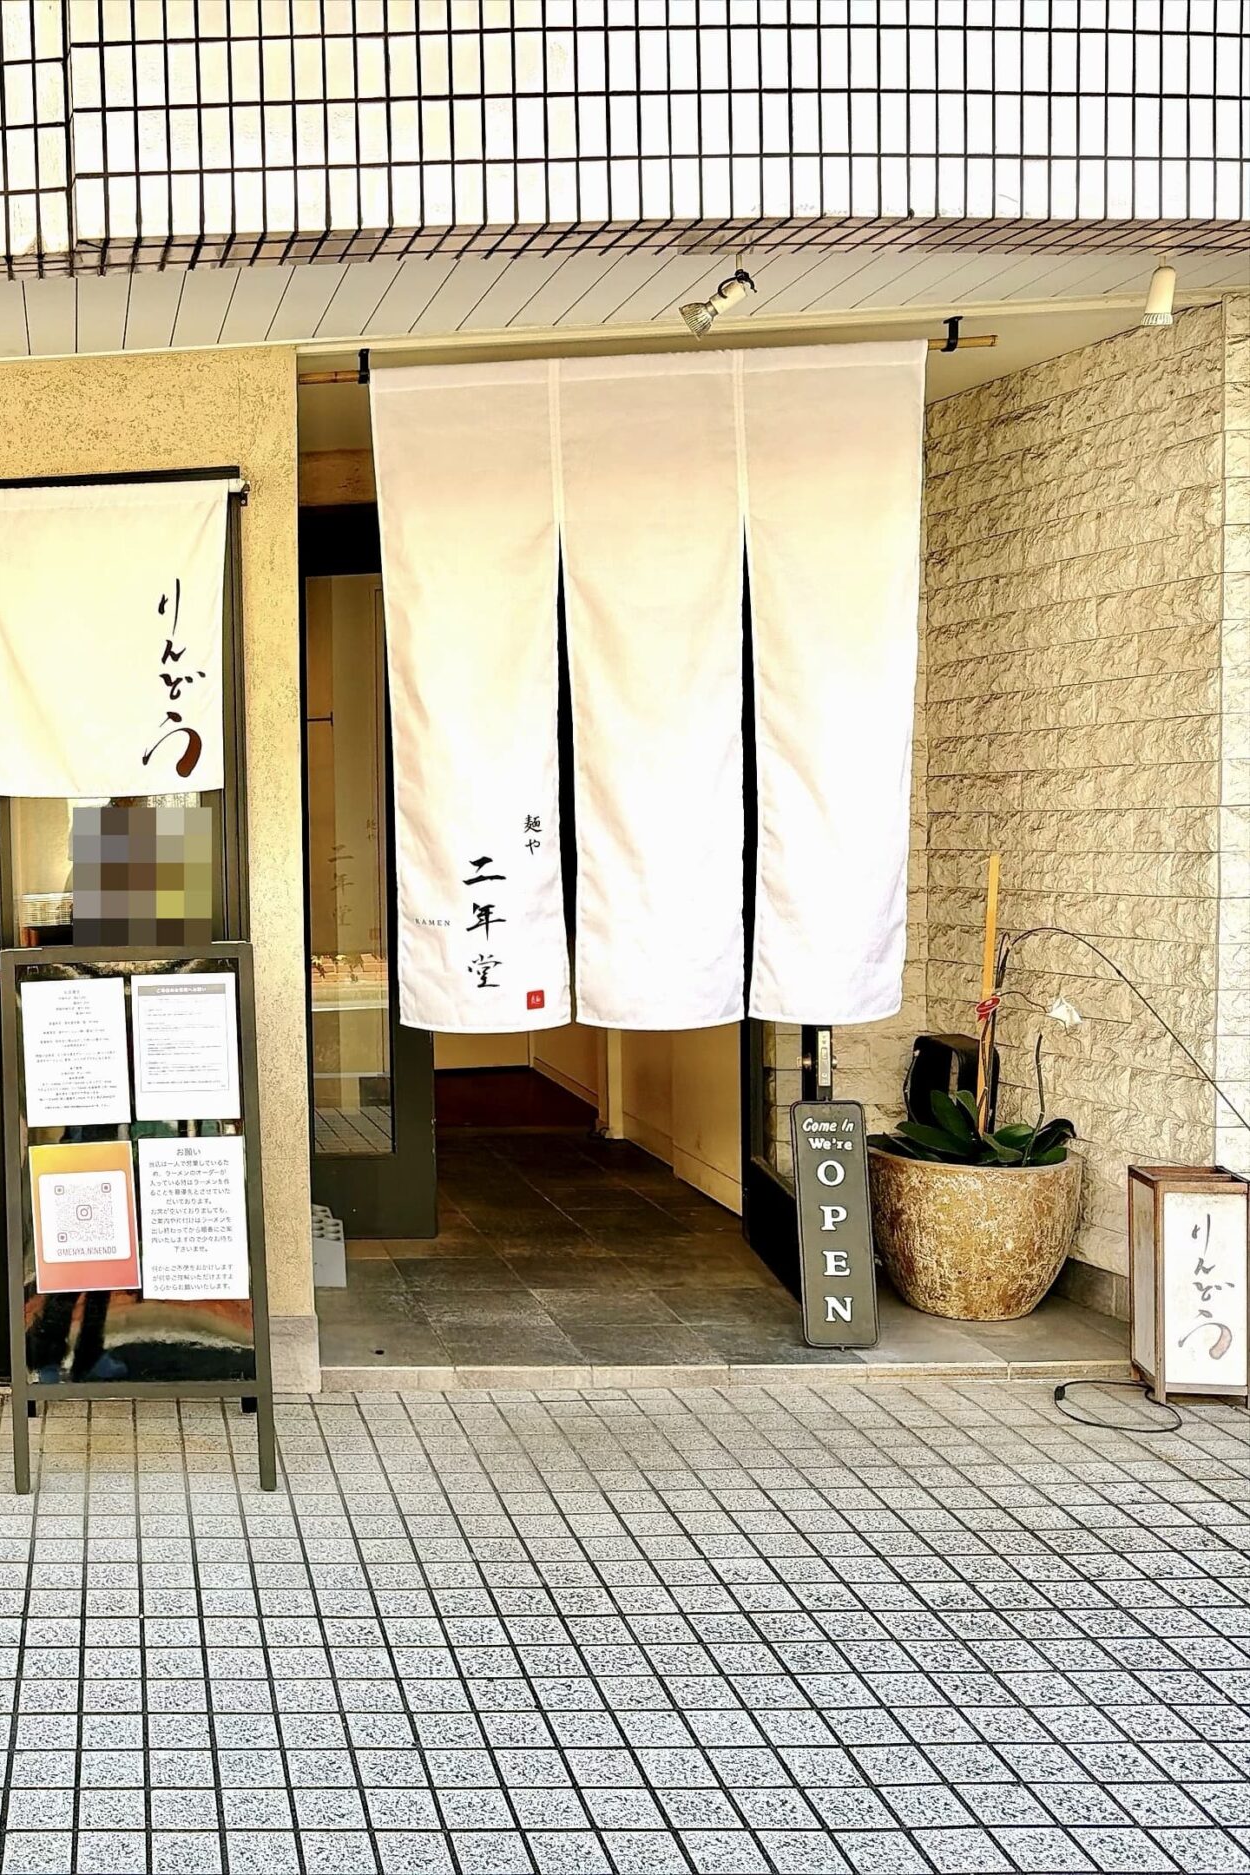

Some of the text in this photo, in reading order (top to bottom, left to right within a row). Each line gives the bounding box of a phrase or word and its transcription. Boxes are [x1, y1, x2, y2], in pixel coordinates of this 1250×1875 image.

[142, 578, 206, 778] りんどう
[524, 814, 543, 855] 麺や
[462, 855, 507, 989] 二年堂
[176, 1147, 201, 1156] お願い
[802, 1117, 854, 1132] Come In
[808, 1137, 853, 1151] We're
[816, 1160, 853, 1323] OPEN
[1177, 1213, 1236, 1361] りんどう
